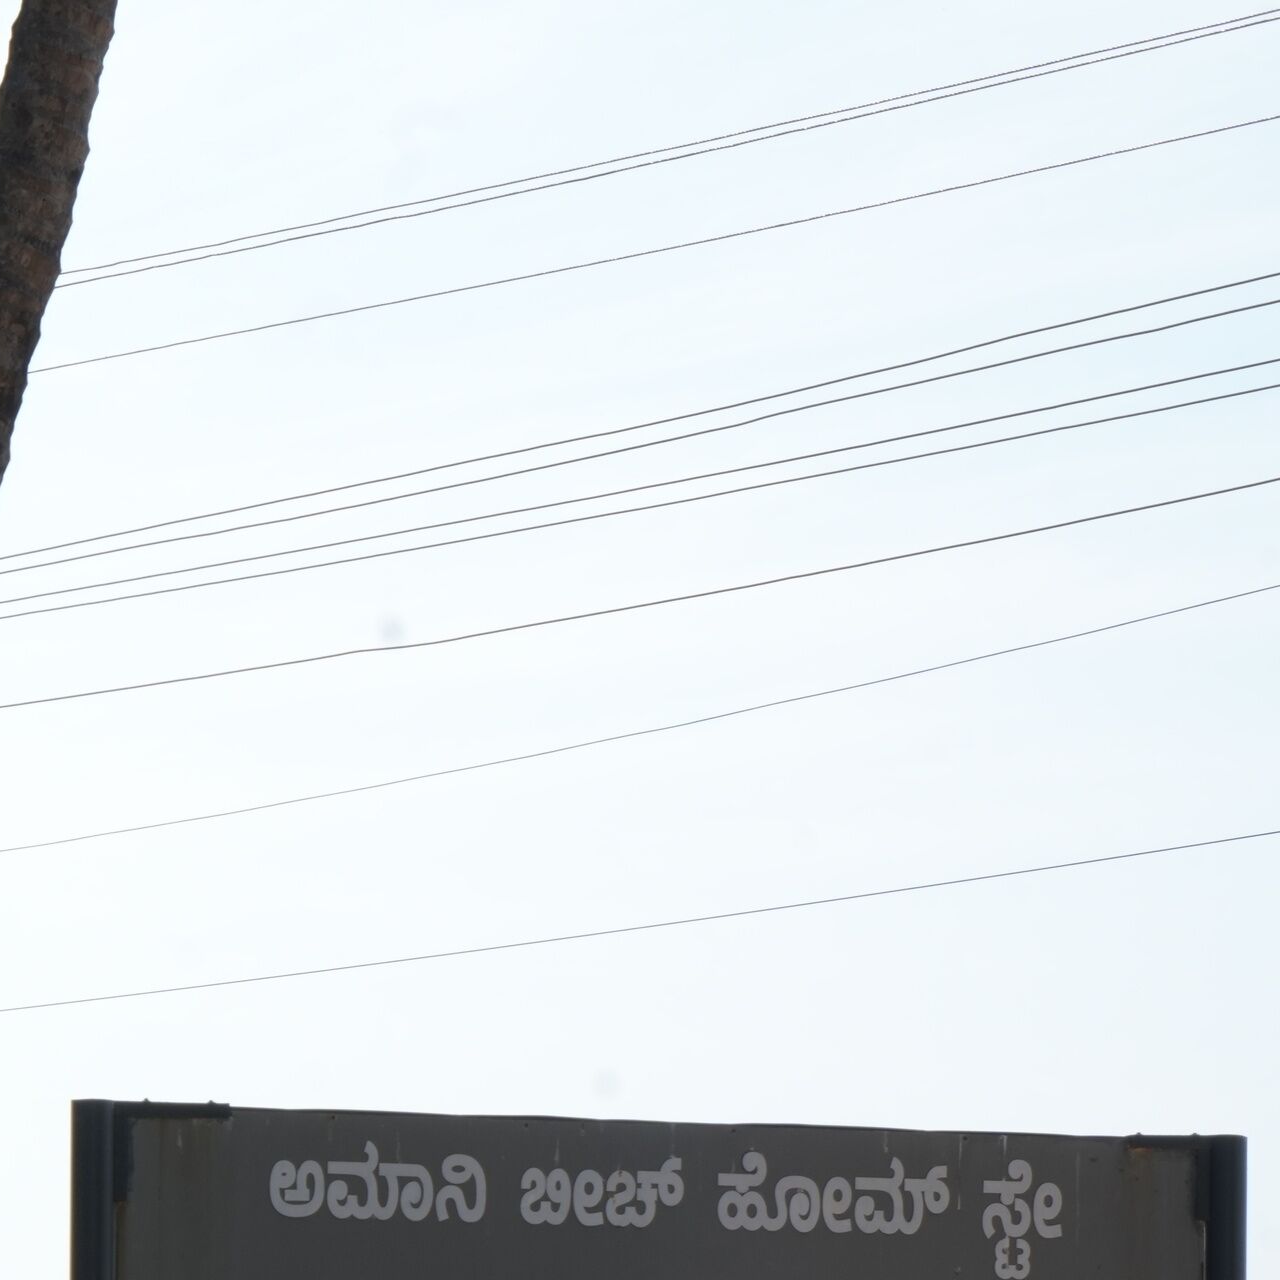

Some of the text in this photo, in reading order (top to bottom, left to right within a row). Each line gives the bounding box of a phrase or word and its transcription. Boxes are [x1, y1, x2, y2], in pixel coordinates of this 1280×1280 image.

[269, 1141, 1063, 1280] ಅಮಾನಿ ಬೀಚ್ ಹೋಮ್ ಸ್ಟೇ
